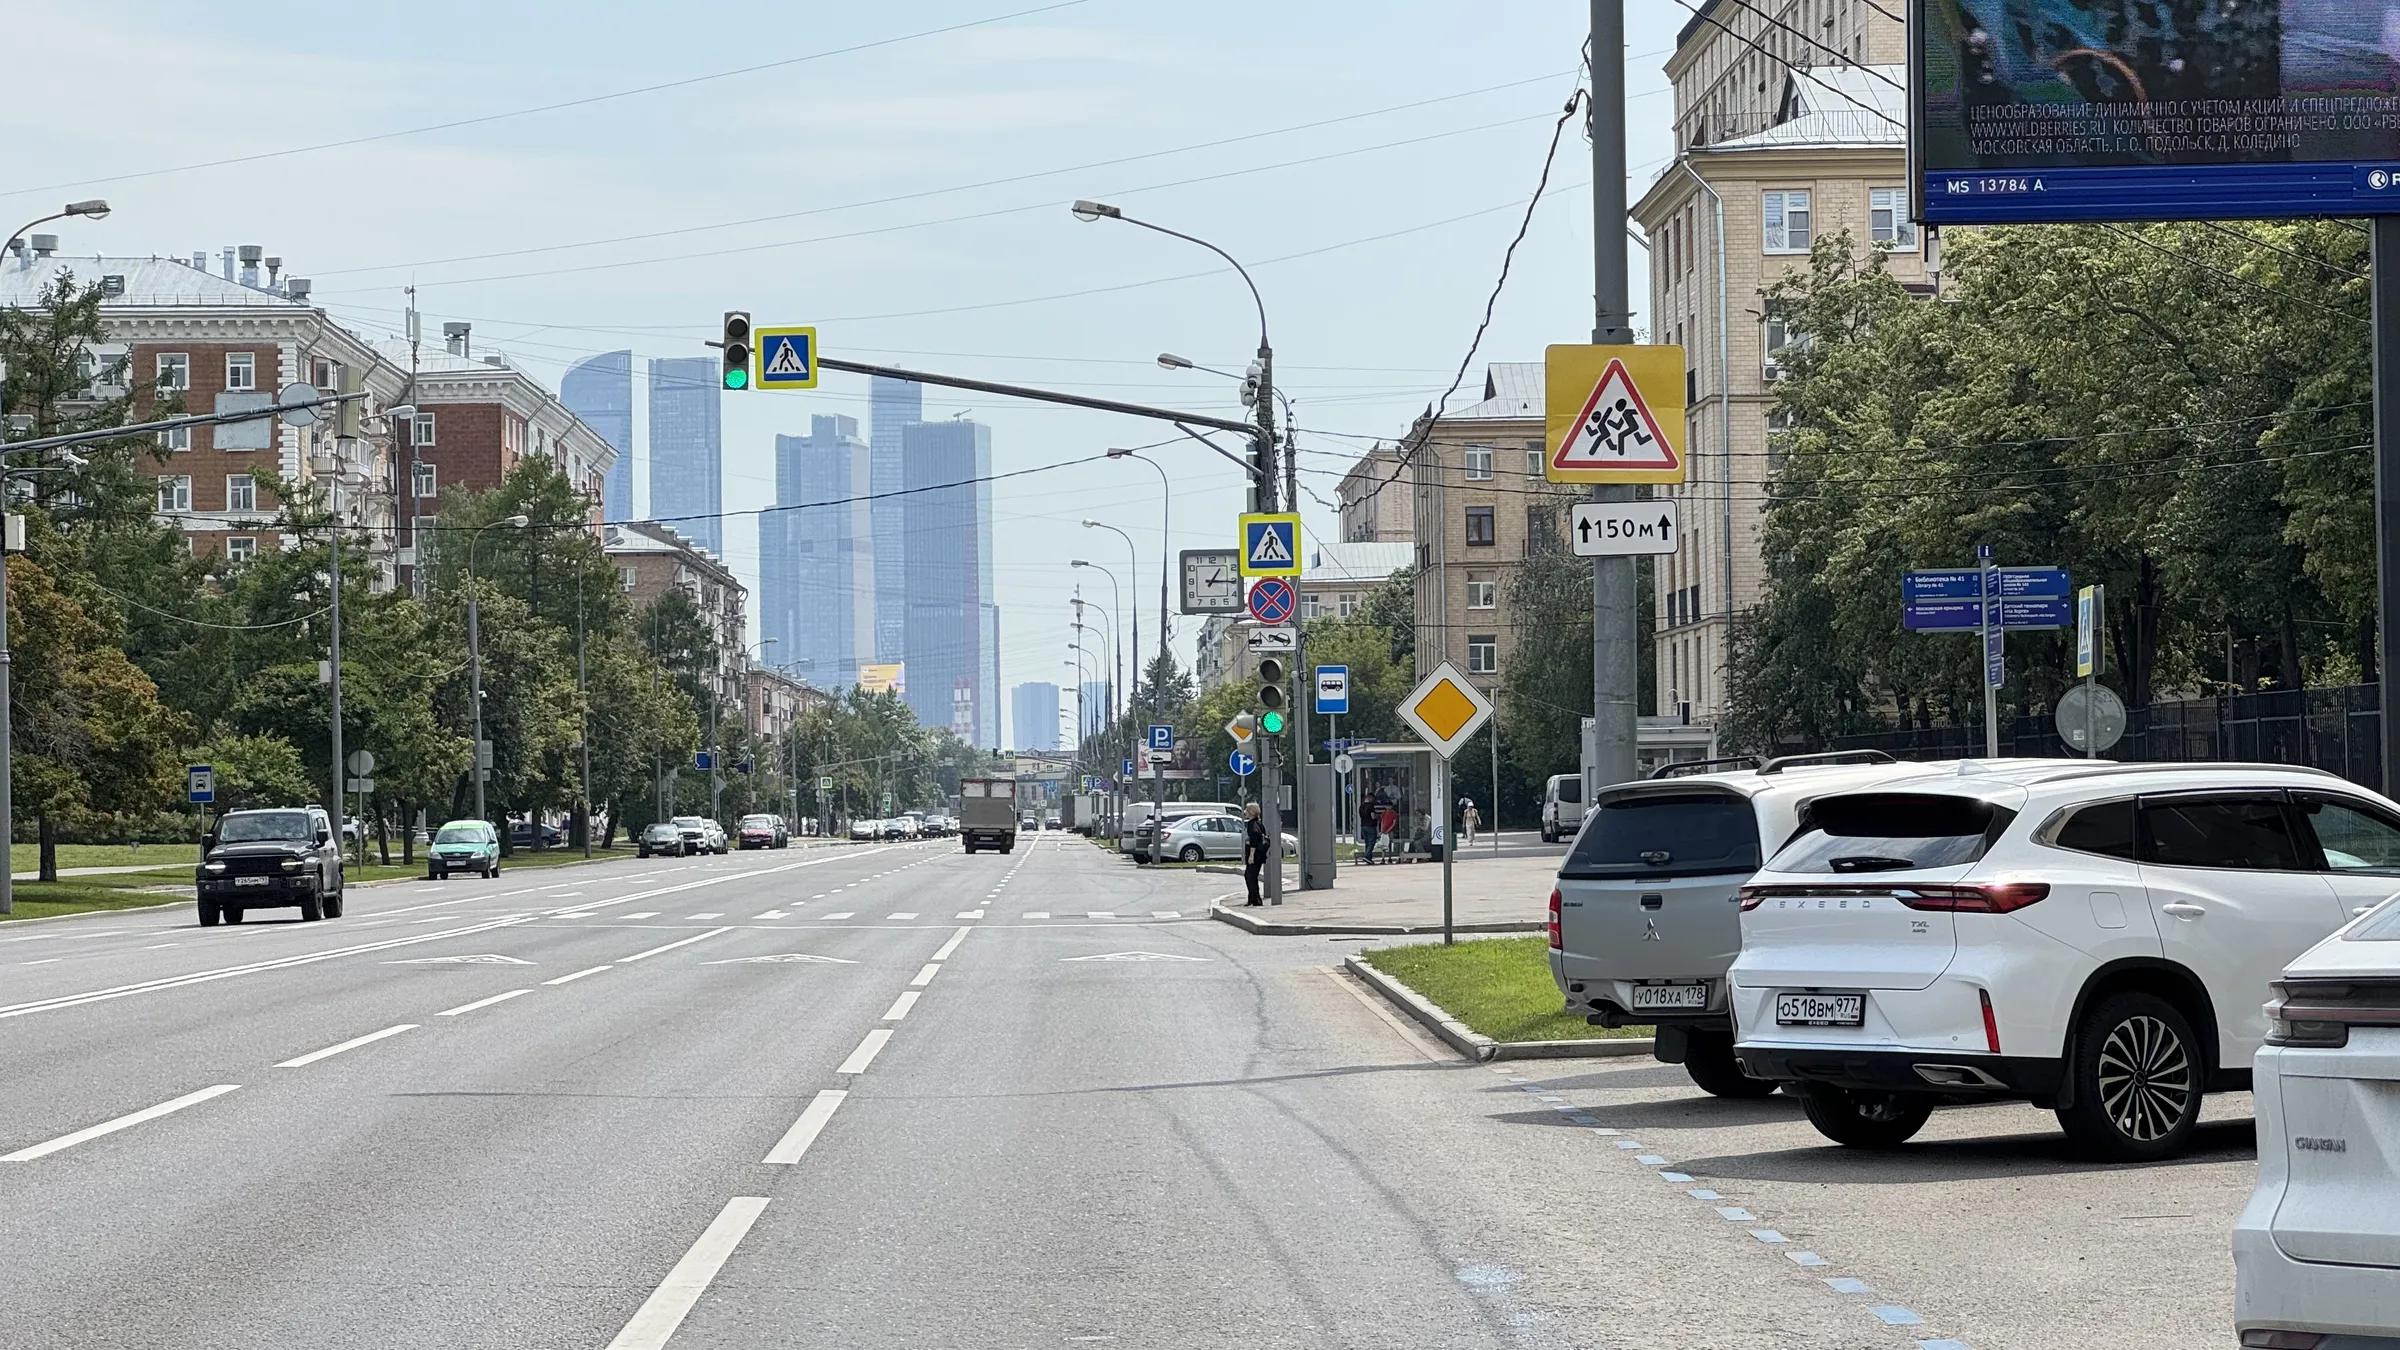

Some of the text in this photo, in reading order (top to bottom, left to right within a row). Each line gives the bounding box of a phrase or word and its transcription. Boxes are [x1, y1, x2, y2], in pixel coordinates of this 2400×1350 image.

[1970, 102, 2091, 121] ЦЕНООБРАЗОВАНИЕ
[2095, 101, 2177, 119] ДИНАМИЧНО
[2181, 101, 2188, 116] С
[2190, 100, 2240, 115] УЧЕТОМ
[2244, 97, 2285, 116] АКЦИЙ
[2290, 98, 2298, 113] И
[2113, 118, 2193, 134] КОЛИЧЕСТВО
[2197, 117, 2251, 133] ТОВАРОВ
[2255, 116, 2339, 132] ОГРАНИЧЕНО.
[2343, 115, 2370, 129] ООО
[1971, 133, 2300, 155] МОСКОВСКАЯ ОБЛАСТЬ, Г. О. ПОДОЛЬСК, Д. КОЛЕДИНО
[1948, 181, 1969, 193] MS
[1980, 179, 2027, 192] 13784
[1155, 728, 1168, 746] P
[1685, 987, 1703, 999] 178
[1836, 998, 1856, 1012] 977
